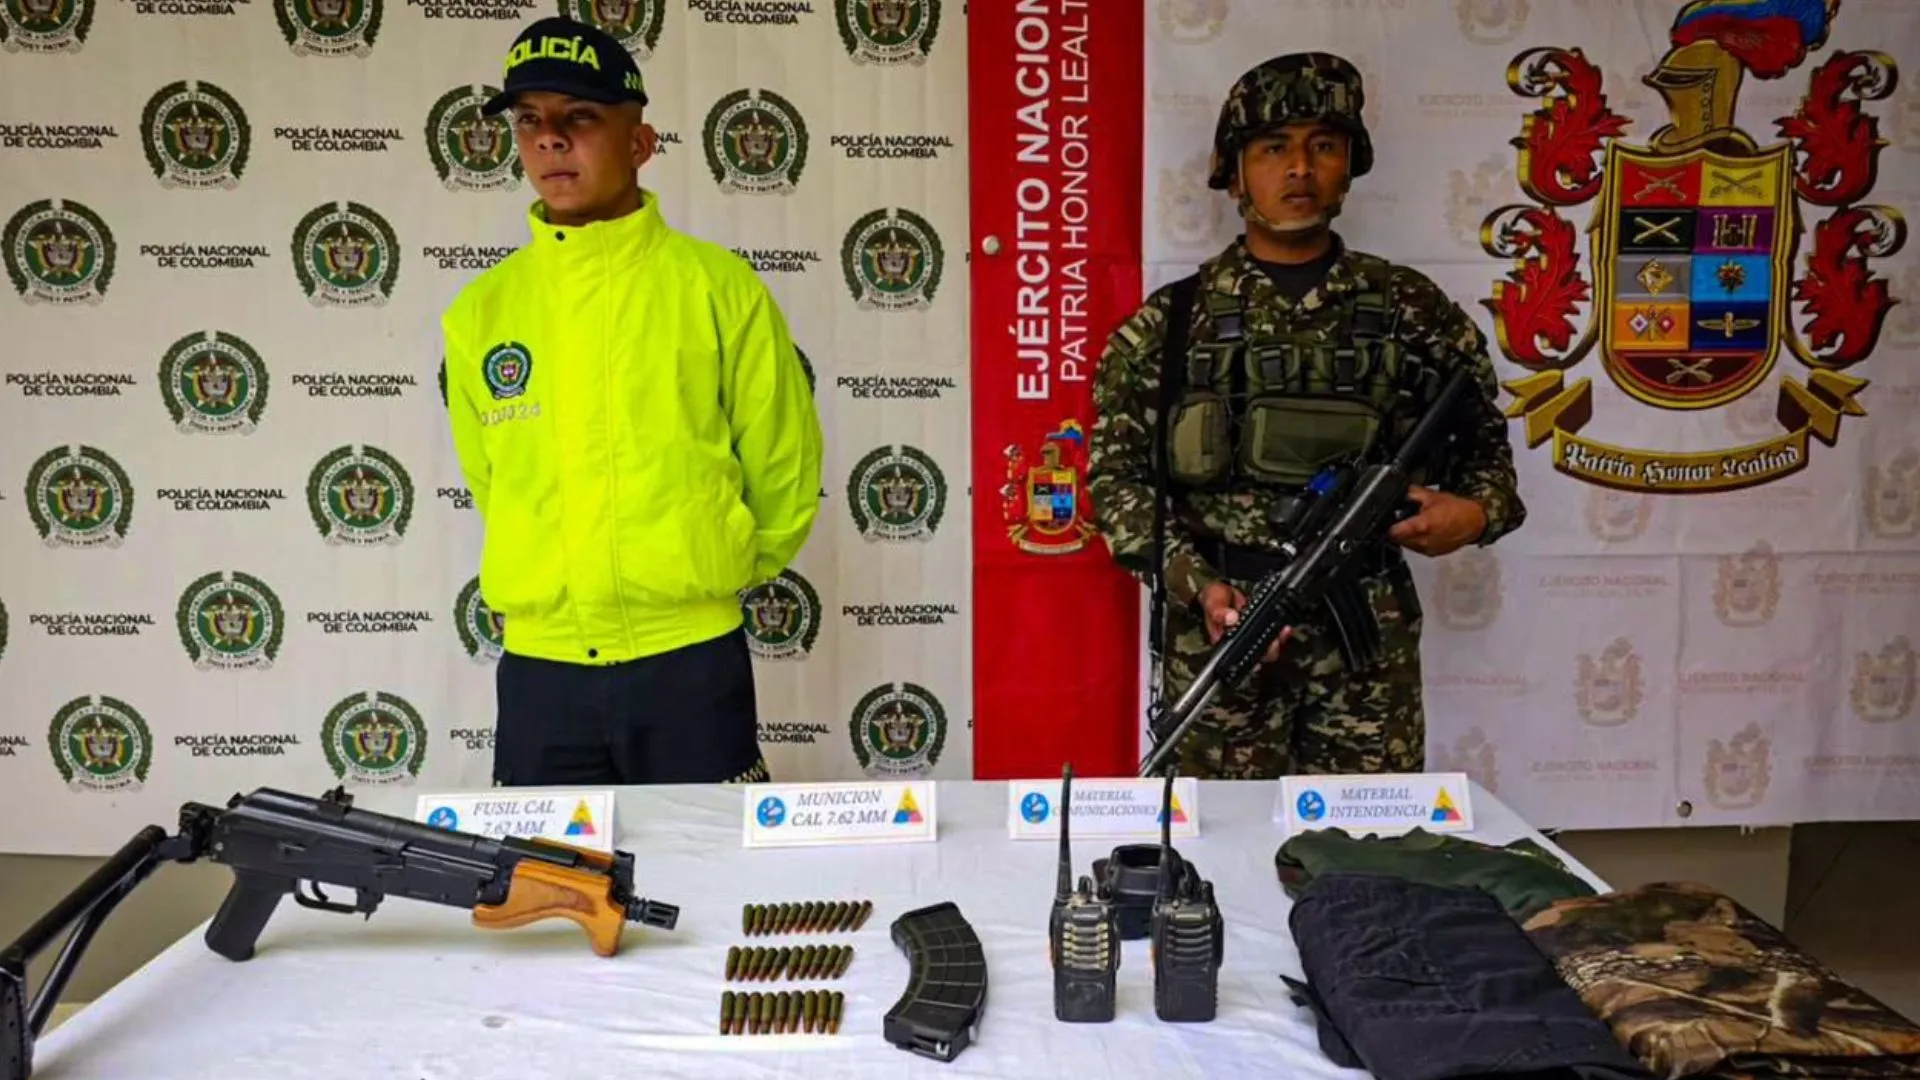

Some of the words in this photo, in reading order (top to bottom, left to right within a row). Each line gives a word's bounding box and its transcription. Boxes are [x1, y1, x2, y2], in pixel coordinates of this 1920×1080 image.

[137, 3, 155, 13] DE
[159, 3, 235, 15] COLOMBIA
[745, 1, 814, 12] NACIONAL
[425, 8, 442, 18] DE
[446, 8, 519, 19] COLOMBIA
[704, 12, 724, 22] DE
[727, 13, 798, 24] COLOMBIA
[1060, 0, 1089, 103] LEALT
[46, 126, 118, 137] NACIONAL
[332, 129, 403, 140] NACIONAL
[4, 136, 23, 147] DE
[28, 137, 102, 148] COLOMBIA
[292, 140, 311, 150] DE
[315, 140, 387, 151] COLOMBIA
[885, 136, 953, 147] NACIONAL
[846, 147, 864, 158] DE
[867, 148, 938, 158] COLOMBIA
[1060, 115, 1089, 249] HONOR
[198, 245, 270, 257] NACIONAL
[752, 249, 822, 261] NACIONAL
[158, 257, 177, 267] DE
[180, 257, 253, 268] COLOMBIA
[439, 258, 460, 269] DE
[1008, 178, 1050, 400] EJÉRCITO
[1060, 258, 1088, 382] PATRIA
[63, 374, 137, 385] NACIONAL
[348, 375, 418, 386] NACIONAL
[889, 377, 956, 388] NACIONAL
[23, 385, 42, 396] DE
[46, 385, 121, 396] COLOMBIA
[308, 386, 327, 396] DE
[330, 386, 402, 397] COLOMBIA
[852, 388, 870, 398] DE
[872, 388, 940, 399] COLOMBIA
[1566, 443, 1636, 479] Patria
[215, 489, 287, 499] NACIONAL
[174, 500, 193, 511] DE
[196, 500, 271, 511] COLOMBIA
[894, 605, 959, 615] NACIONAL
[84, 614, 156, 625] NACIONAL
[363, 611, 433, 622] NACIONAL
[857, 616, 875, 626] DE
[877, 615, 944, 626] COLOMBIA
[47, 625, 66, 635] DE
[68, 625, 140, 635] COLOMBIA
[324, 623, 343, 633] DE
[345, 623, 418, 633] COLOMBIA
[766, 722, 831, 734] NACIONAL
[230, 735, 301, 745] NACIONAL
[758, 732, 815, 744] OLOMBIA
[192, 746, 210, 756] DE
[213, 746, 284, 756] COLOMBIA
[796, 789, 882, 807] MUNICION
[1074, 789, 1136, 801] MATERIAL
[1340, 786, 1413, 800] MATERIAL
[473, 801, 520, 816] FUSIL
[523, 800, 556, 815] CAL
[1051, 804, 1158, 818] CMUNICACIONES
[1329, 805, 1427, 819] INTENDENCIA
[791, 810, 822, 827] CAL
[827, 810, 854, 827] 7.62
[857, 809, 888, 825] MM
[483, 821, 511, 836] 7.62
[513, 821, 546, 835] MM
